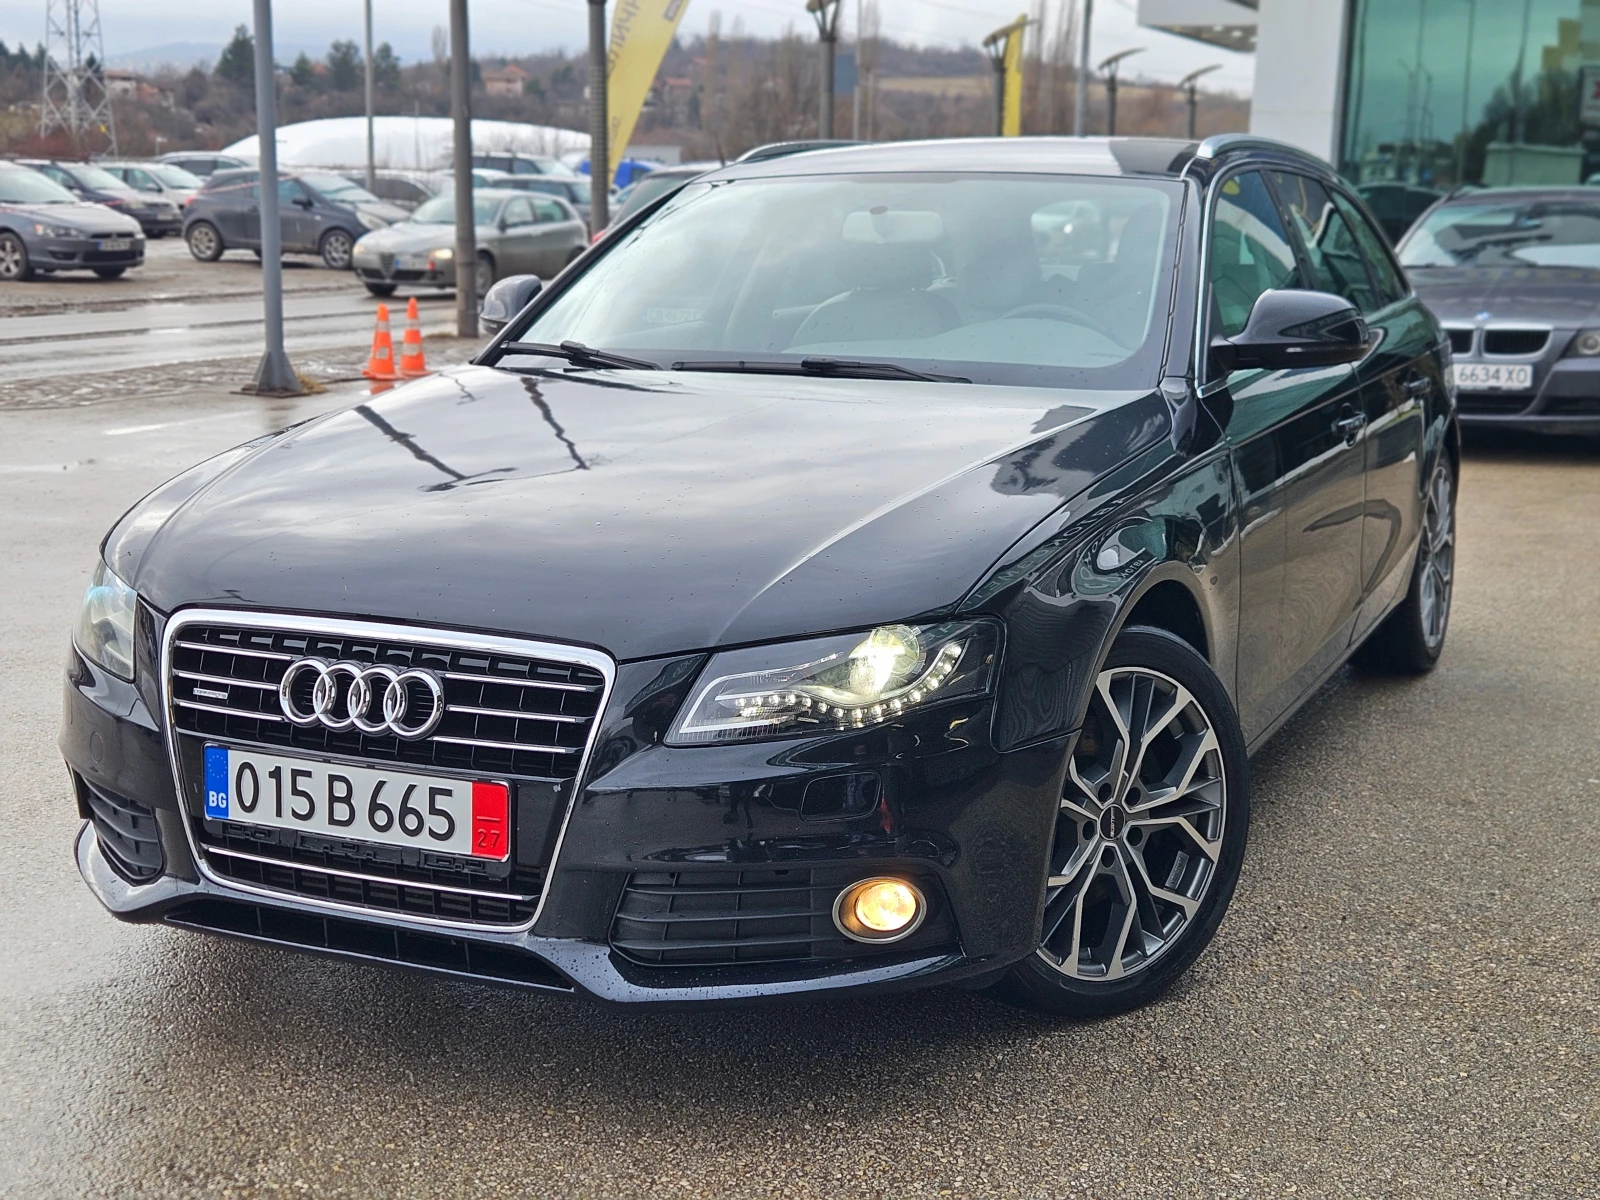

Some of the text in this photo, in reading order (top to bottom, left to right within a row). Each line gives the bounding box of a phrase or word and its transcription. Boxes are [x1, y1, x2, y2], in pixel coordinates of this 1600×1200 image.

[1459, 366, 1501, 383] 6634
[208, 790, 227, 809] BG
[477, 828, 501, 848] 27
